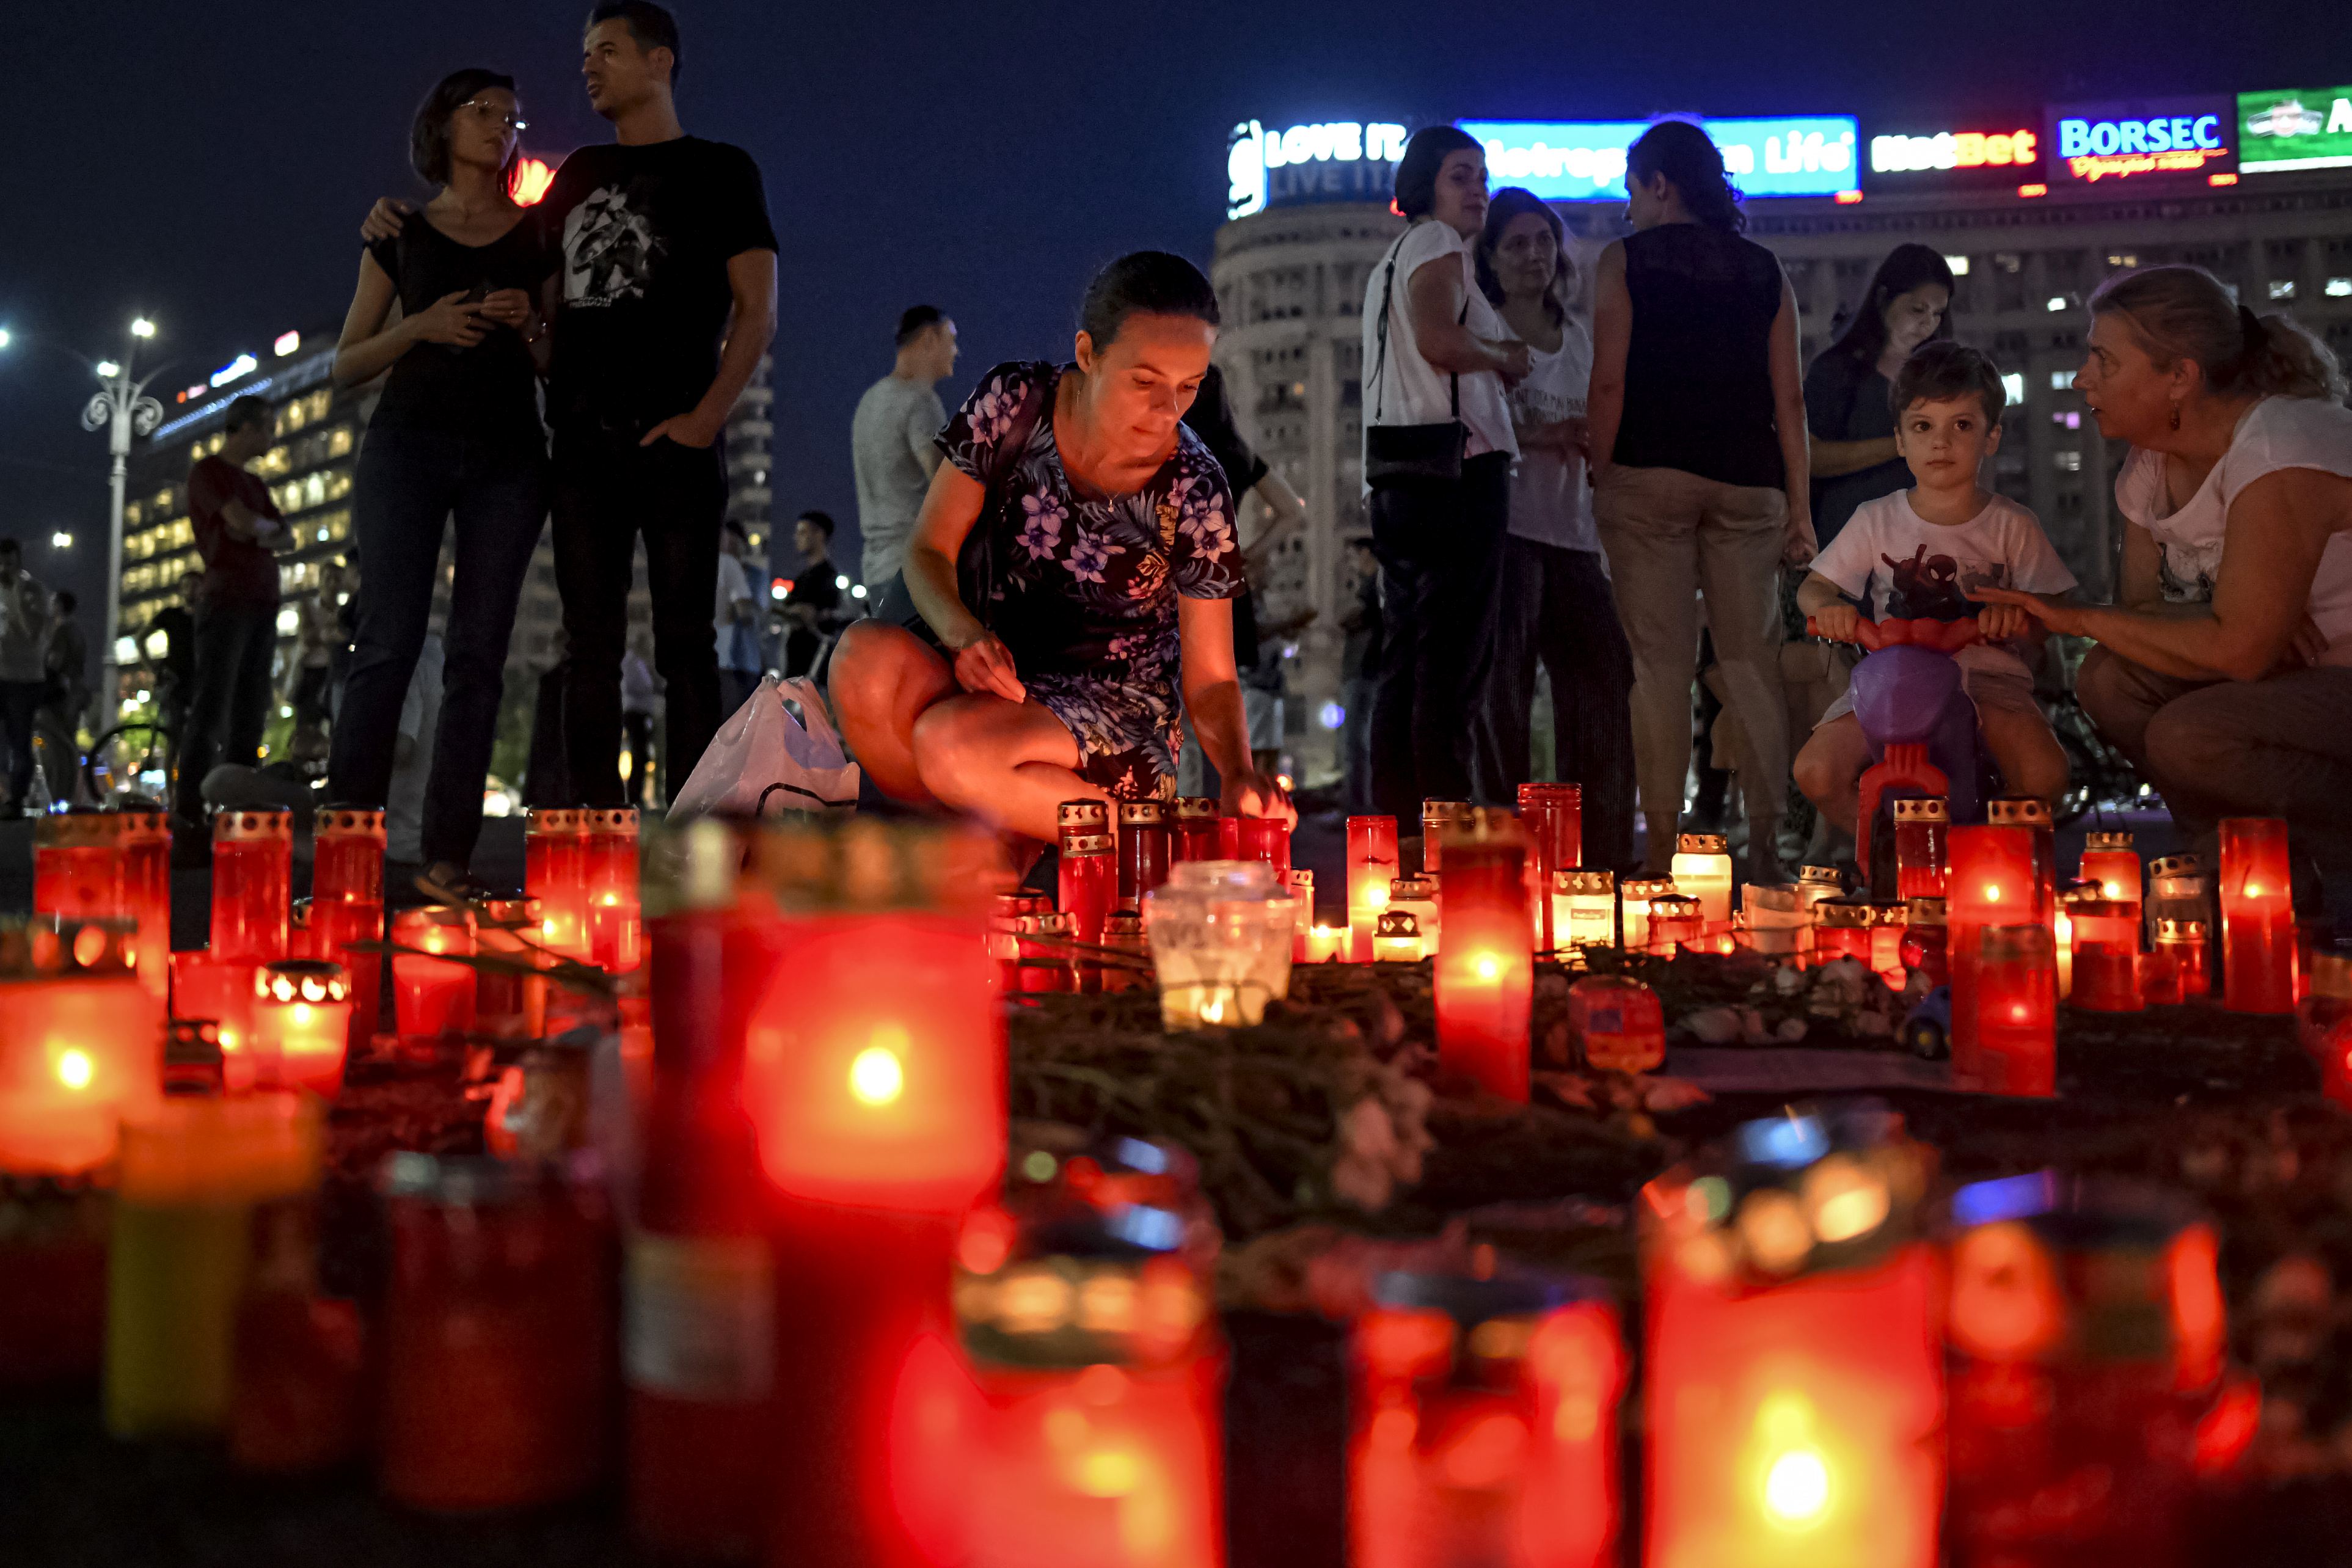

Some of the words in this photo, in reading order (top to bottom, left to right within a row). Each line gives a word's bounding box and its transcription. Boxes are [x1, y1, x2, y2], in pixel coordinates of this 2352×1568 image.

[1265, 122, 1363, 168] LOVE
[1871, 129, 2037, 172] NetBet
[2059, 115, 2221, 158] BORSEC
